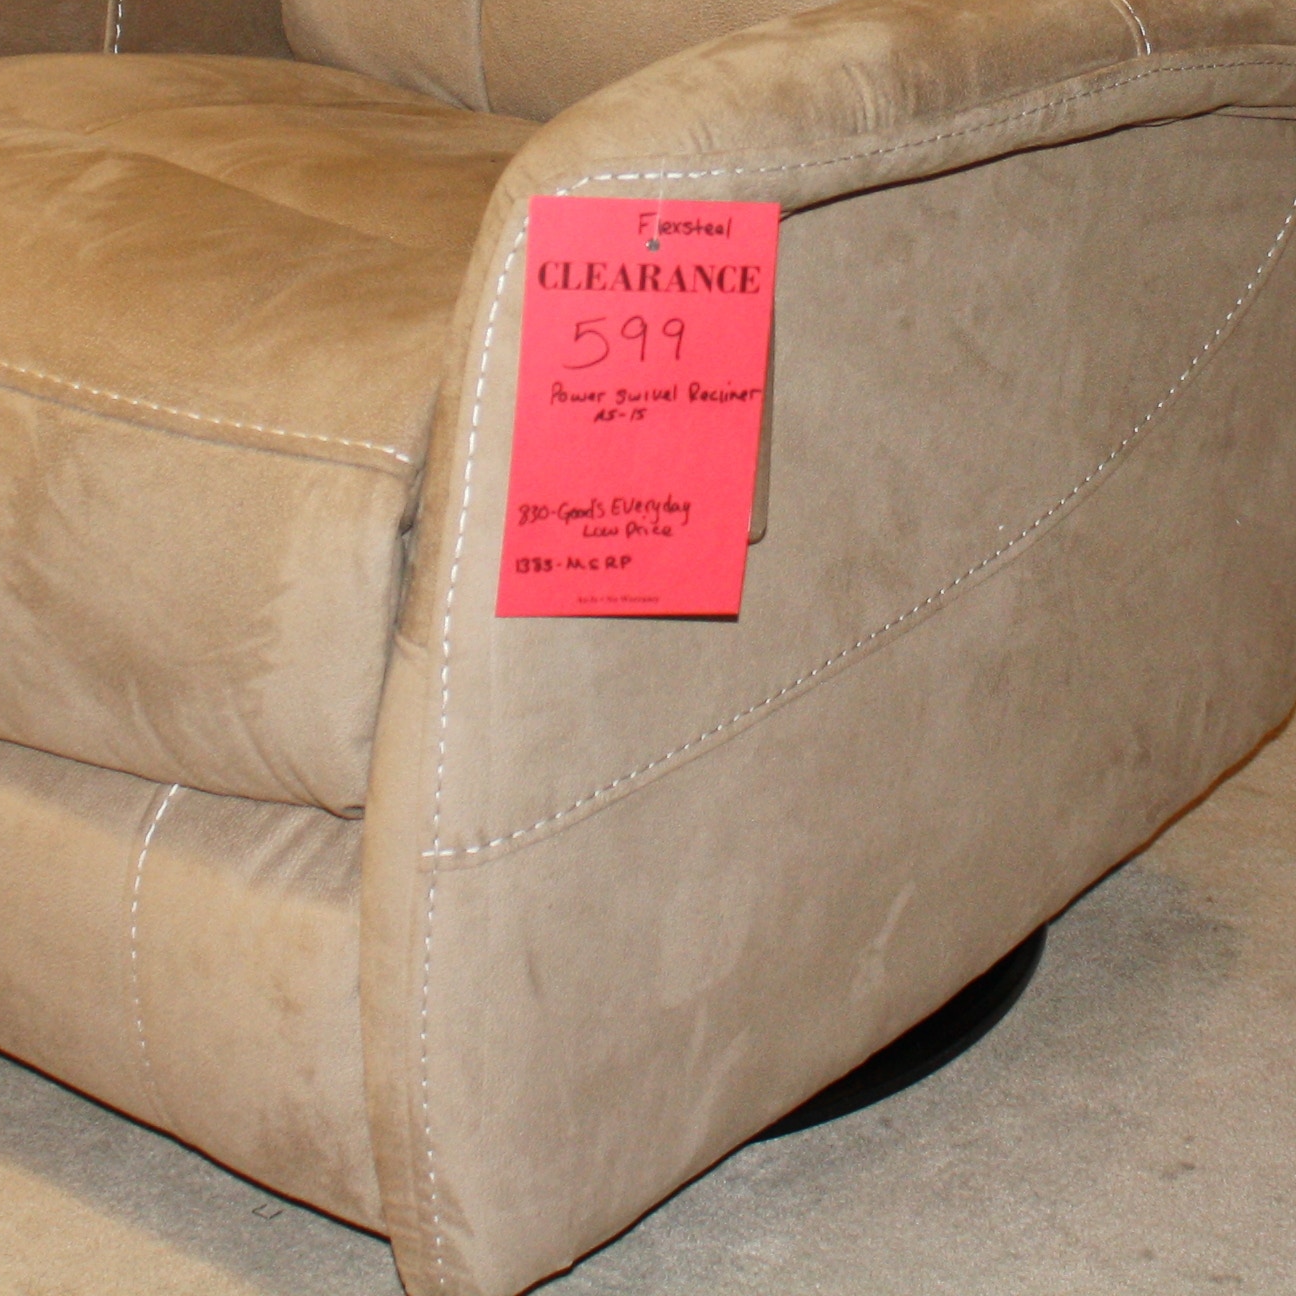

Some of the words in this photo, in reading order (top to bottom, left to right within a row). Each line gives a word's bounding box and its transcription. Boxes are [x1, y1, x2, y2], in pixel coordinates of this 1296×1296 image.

[537, 260, 762, 295] CLEARANCE
[562, 315, 686, 371] 599
[550, 380, 606, 406] Power
[688, 380, 763, 404] Recliner
